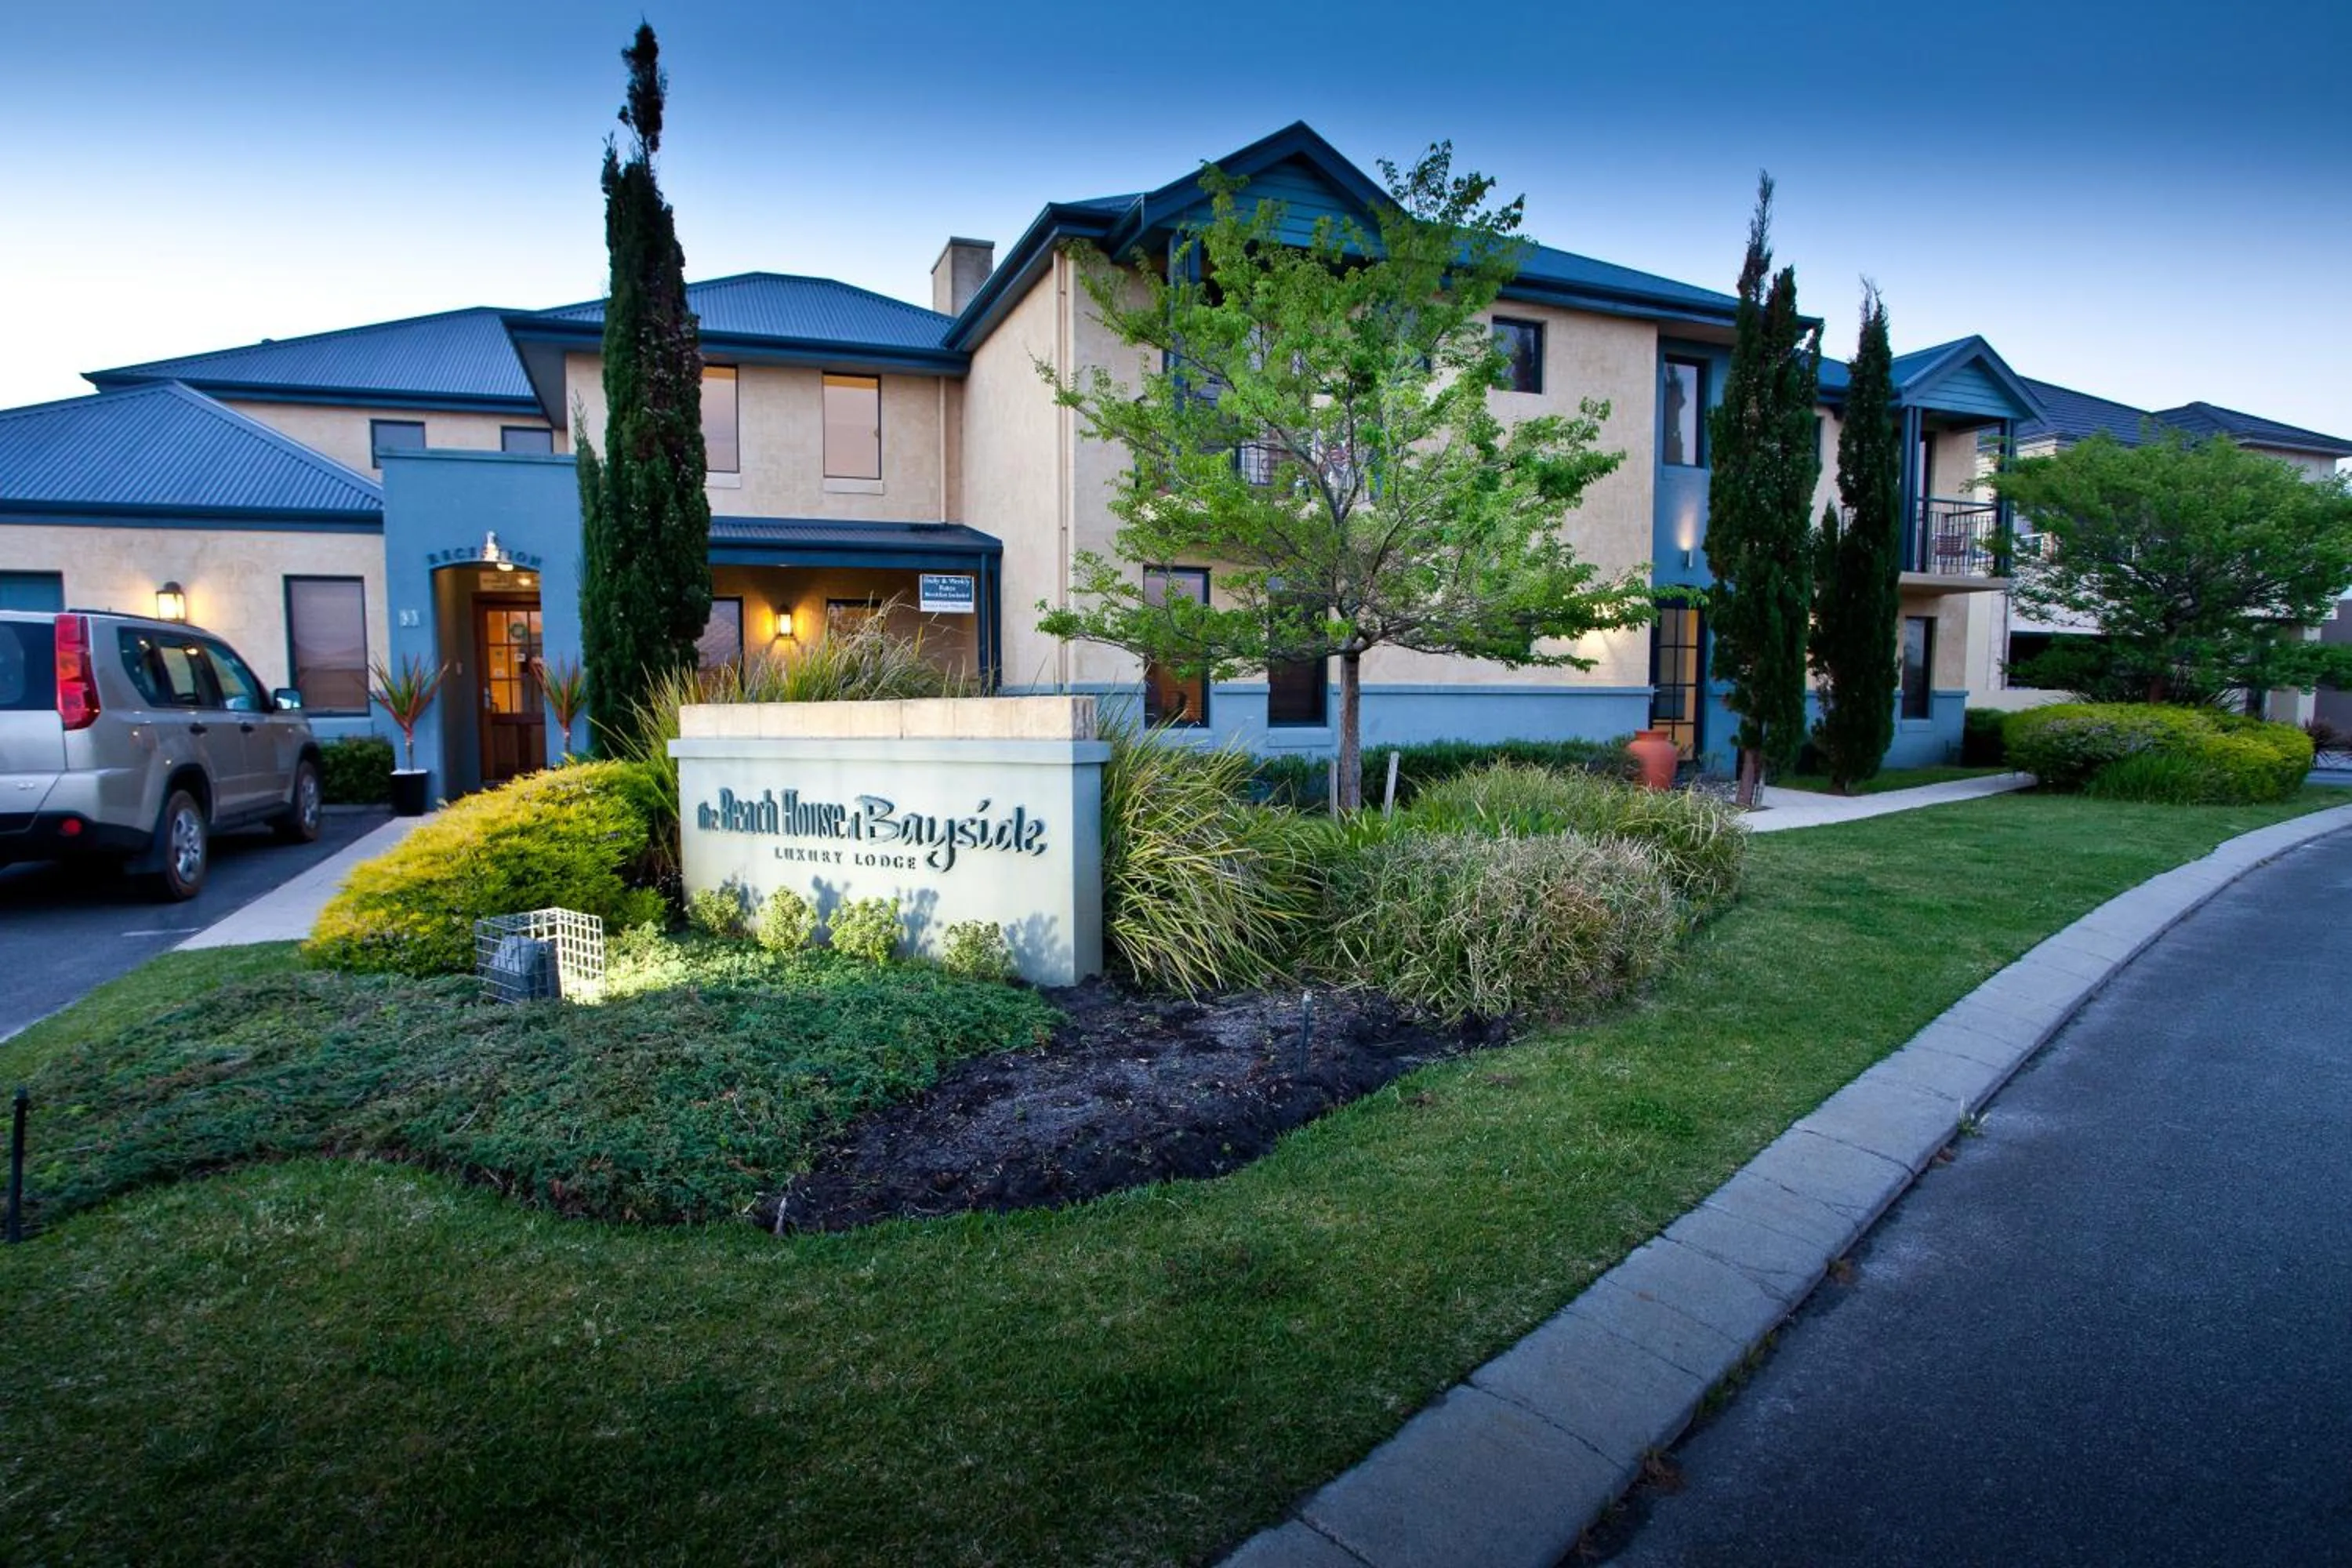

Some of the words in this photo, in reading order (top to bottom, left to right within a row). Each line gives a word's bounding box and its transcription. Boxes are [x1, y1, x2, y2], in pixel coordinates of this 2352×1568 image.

[426, 546, 542, 566] RECEION
[719, 787, 779, 835] Beach
[781, 788, 846, 840] House
[856, 794, 1048, 873] Bayside
[774, 846, 844, 865] LUXURY
[855, 852, 916, 869] LODGE
